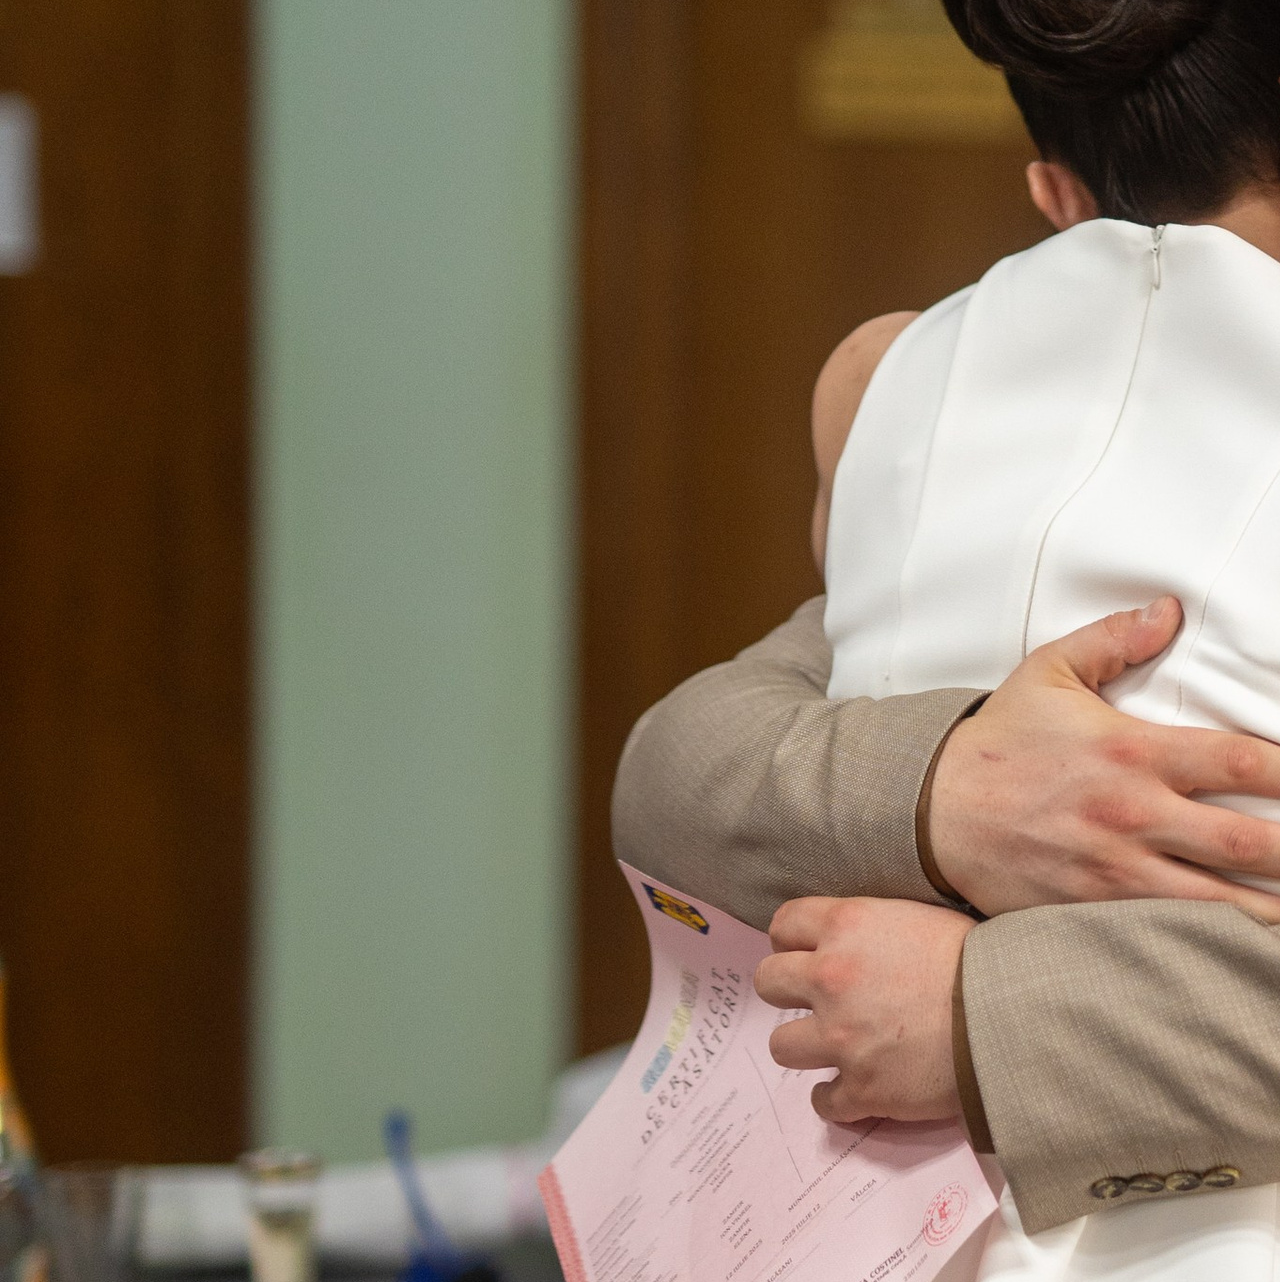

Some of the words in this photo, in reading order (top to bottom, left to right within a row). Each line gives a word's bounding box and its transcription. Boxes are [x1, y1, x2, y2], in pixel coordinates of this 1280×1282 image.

[645, 968, 727, 1122] CERTIFICAT
[640, 1111, 666, 1145] DE
[787, 1176, 824, 1213] MUNICIPIUL
[781, 1228, 797, 1246] 2025
[795, 1211, 813, 1231] IULIE
[812, 1203, 821, 1213] 12
[732, 1254, 749, 1274] IULIE
[748, 1238, 763, 1256] 2025
[869, 1247, 905, 1279] COSTINEL
